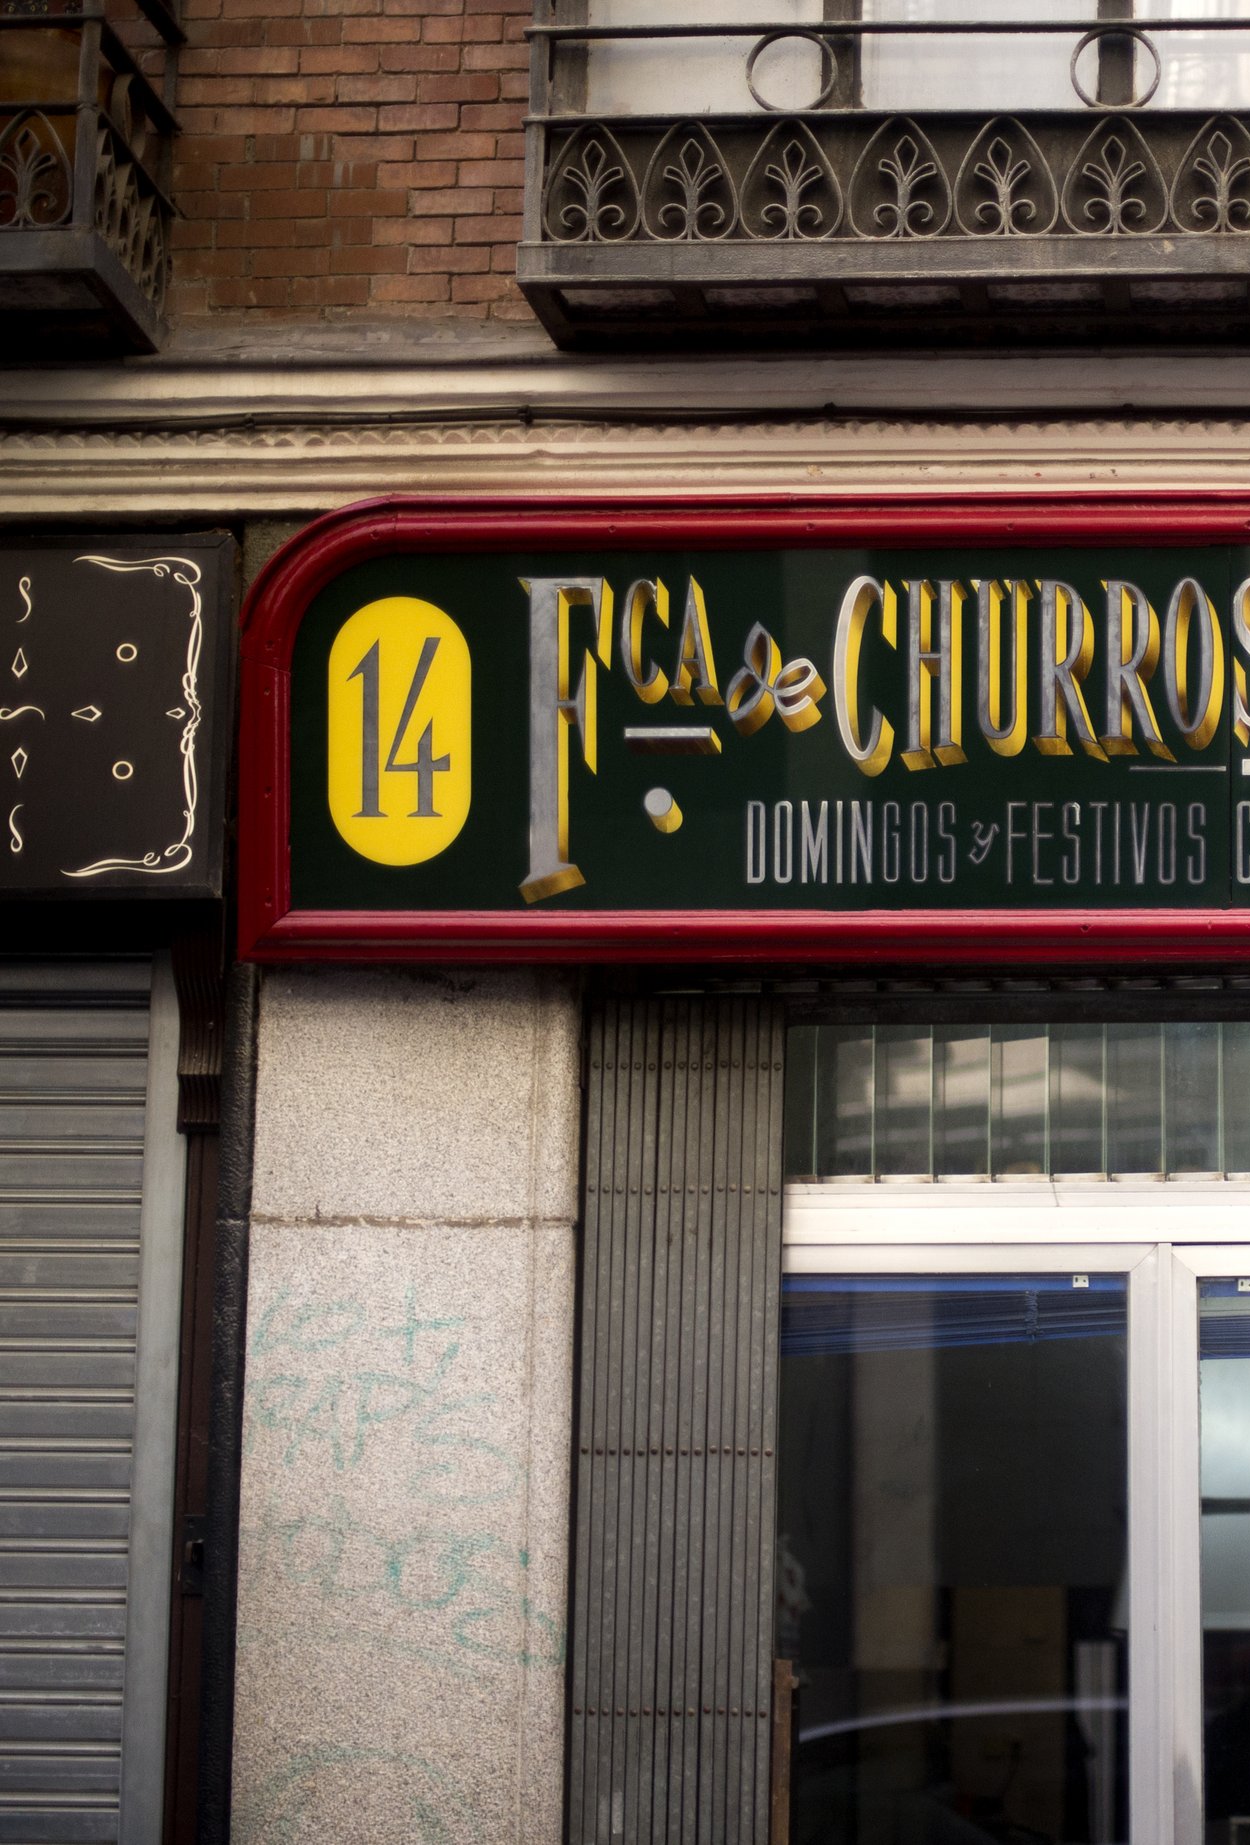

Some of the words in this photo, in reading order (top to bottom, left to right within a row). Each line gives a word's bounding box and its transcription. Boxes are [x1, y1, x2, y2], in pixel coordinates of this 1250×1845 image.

[346, 637, 451, 818] 14
[725, 620, 827, 737] de
[747, 801, 956, 884] DOMINGOS
[968, 821, 999, 865] y
[1007, 801, 1207, 884] FESTIVOS
